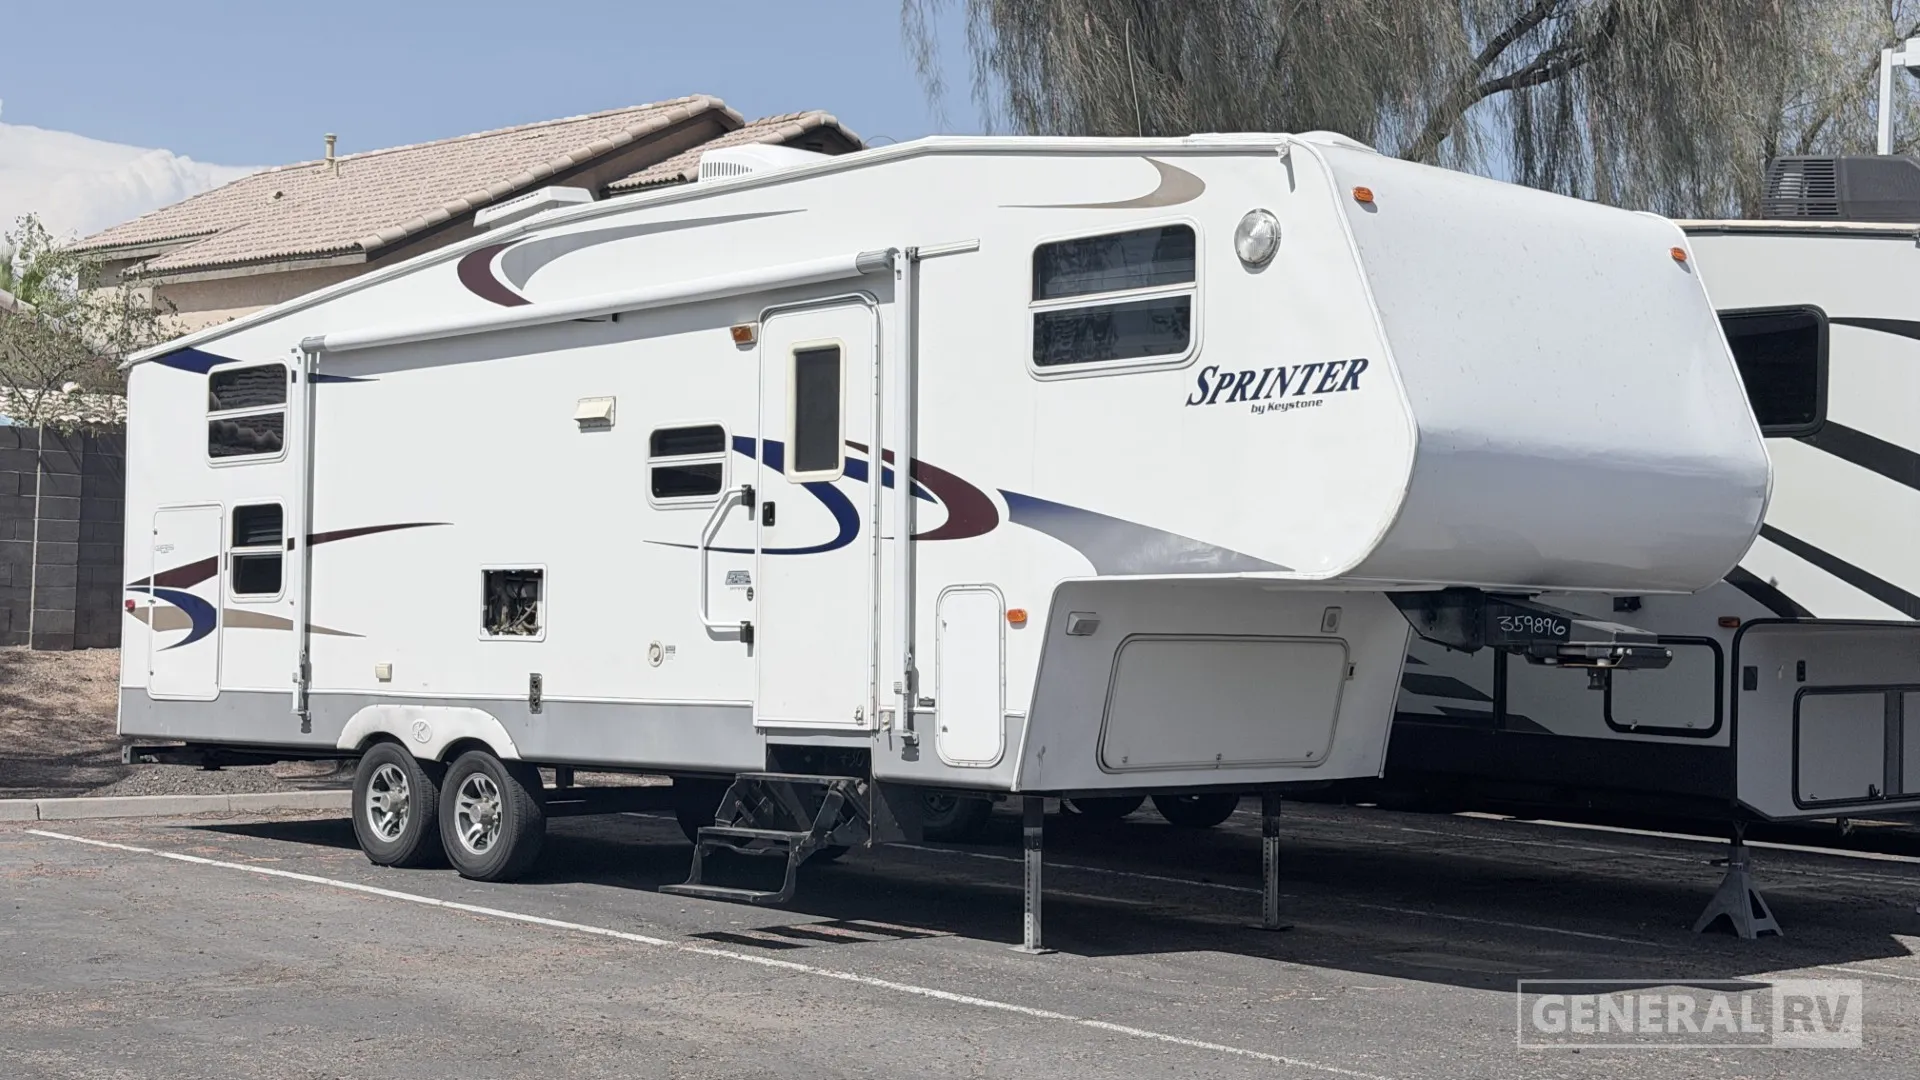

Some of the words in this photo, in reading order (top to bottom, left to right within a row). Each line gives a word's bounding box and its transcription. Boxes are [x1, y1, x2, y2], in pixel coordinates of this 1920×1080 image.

[1185, 358, 1369, 407] SPRINTER
[1250, 404, 1265, 415] by
[1267, 398, 1323, 412] Keystone
[1497, 615, 1566, 636] 359896
